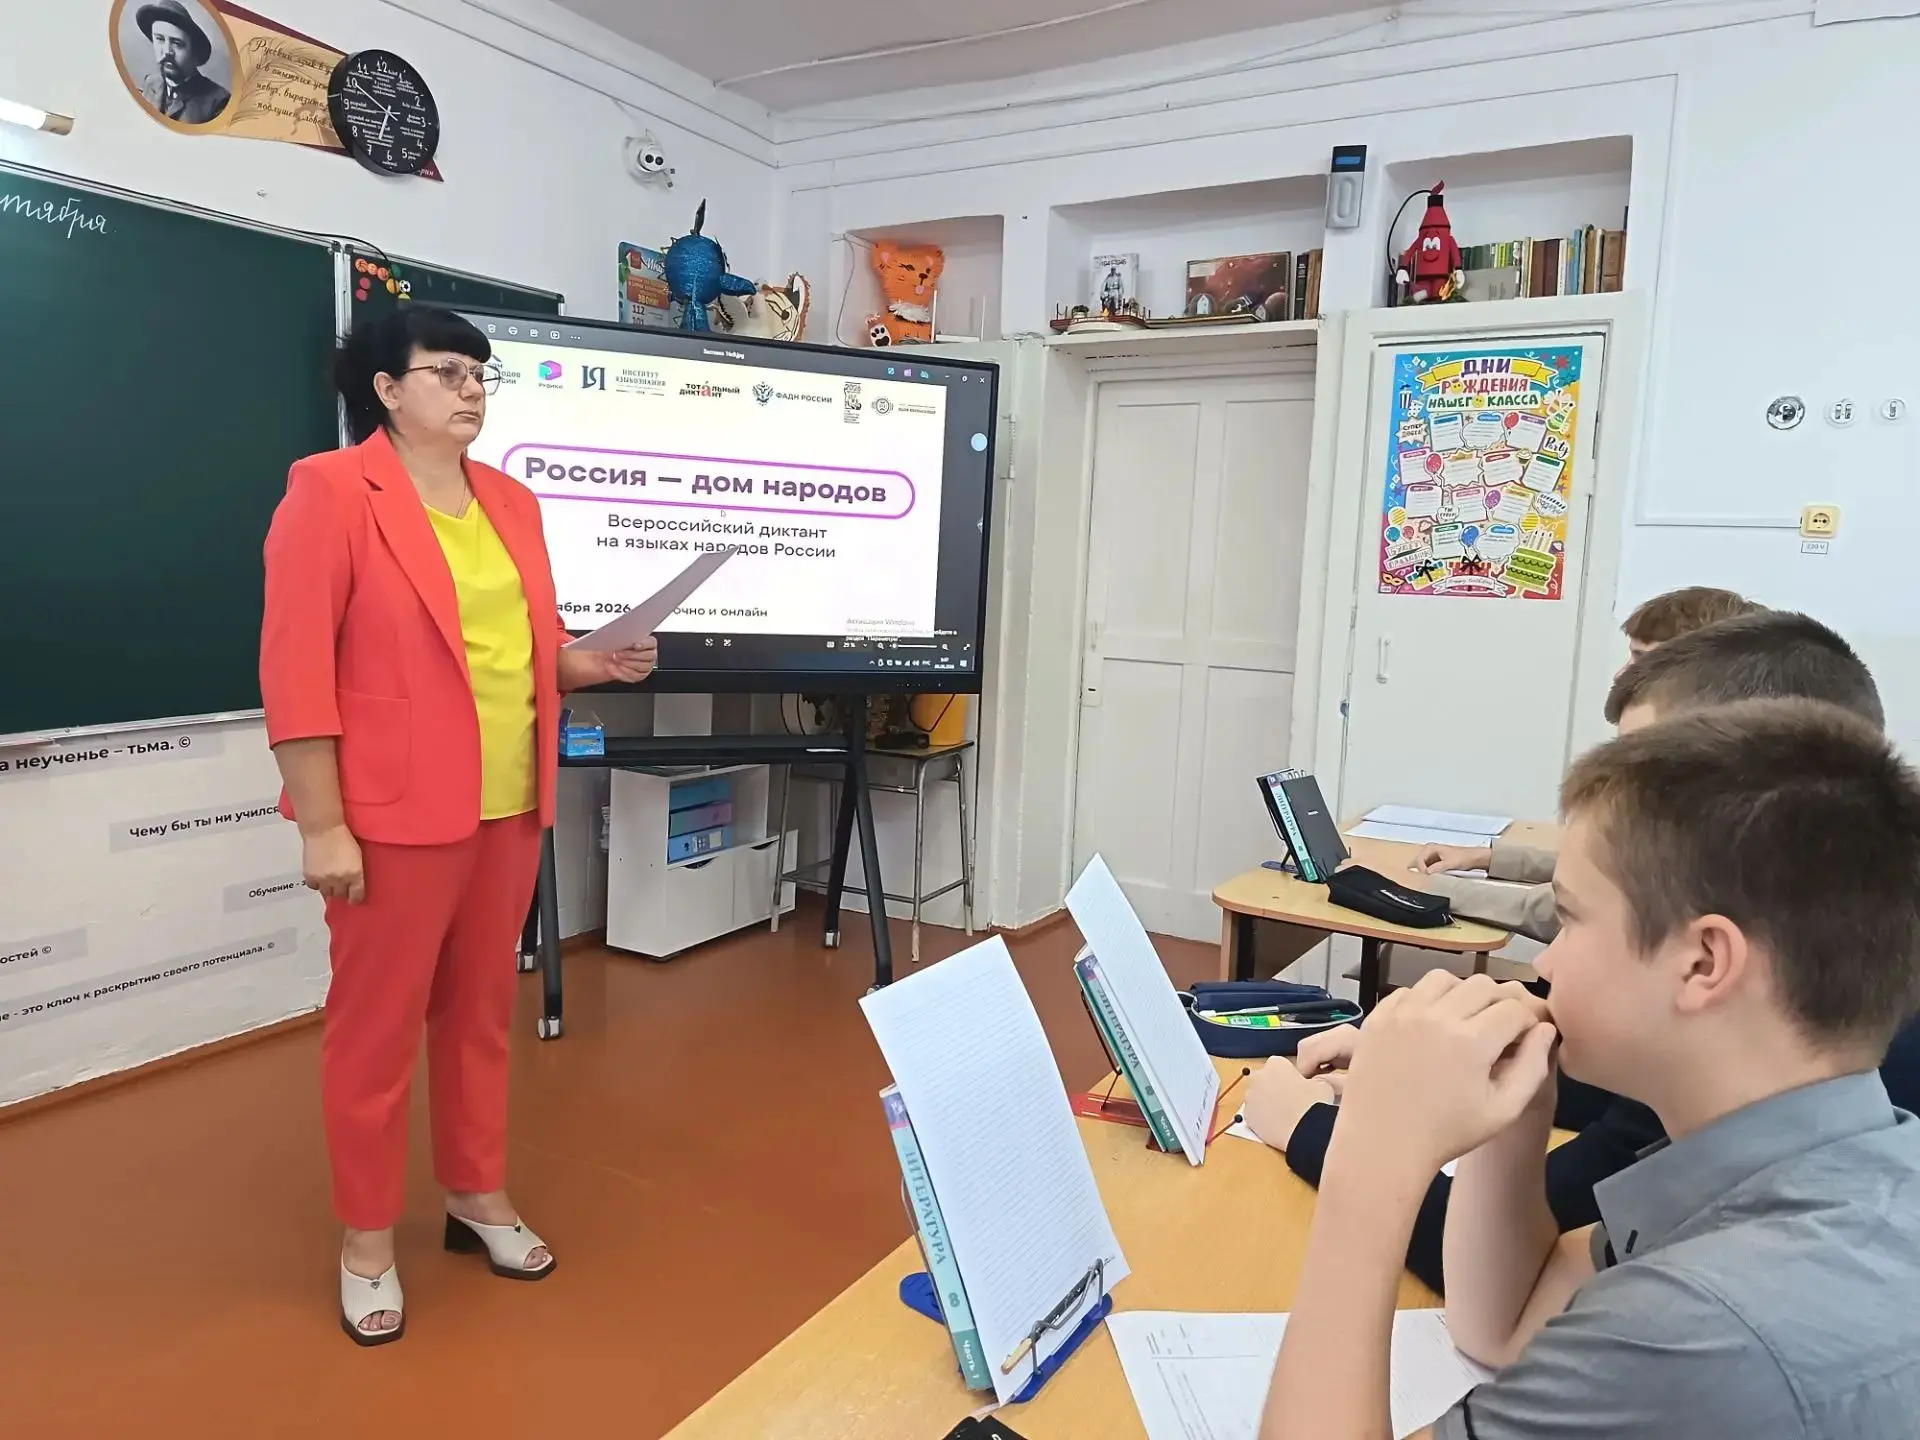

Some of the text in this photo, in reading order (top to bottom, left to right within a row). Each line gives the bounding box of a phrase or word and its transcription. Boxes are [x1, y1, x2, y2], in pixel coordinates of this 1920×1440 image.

[1461, 359, 1511, 378] ДНИ
[1487, 394, 1539, 408] КЛАССА
[1545, 436, 1569, 458] Party
[526, 456, 646, 486] Россия
[692, 474, 753, 495] дом
[763, 479, 886, 504] народов
[608, 513, 828, 539] Всероссийский диктант
[597, 536, 619, 548] на
[625, 537, 689, 551] языках
[774, 542, 836, 559] России
[720, 606, 768, 617] онлайн
[16, 748, 109, 770] неученье
[127, 740, 175, 755] тьма.
[129, 825, 168, 838] Чему
[171, 819, 191, 831] бы
[194, 817, 212, 828] ты
[215, 813, 232, 824] ни
[249, 882, 294, 898] Обучение
[22, 1004, 43, 1016] это
[46, 994, 81, 1009] ключ
[83, 991, 91, 999] к
[94, 972, 161, 998] раскрытию
[163, 962, 200, 978] своего
[202, 945, 265, 968] потенциала.
[948, 1292, 961, 1308] 8
[963, 1339, 976, 1371] Часть
